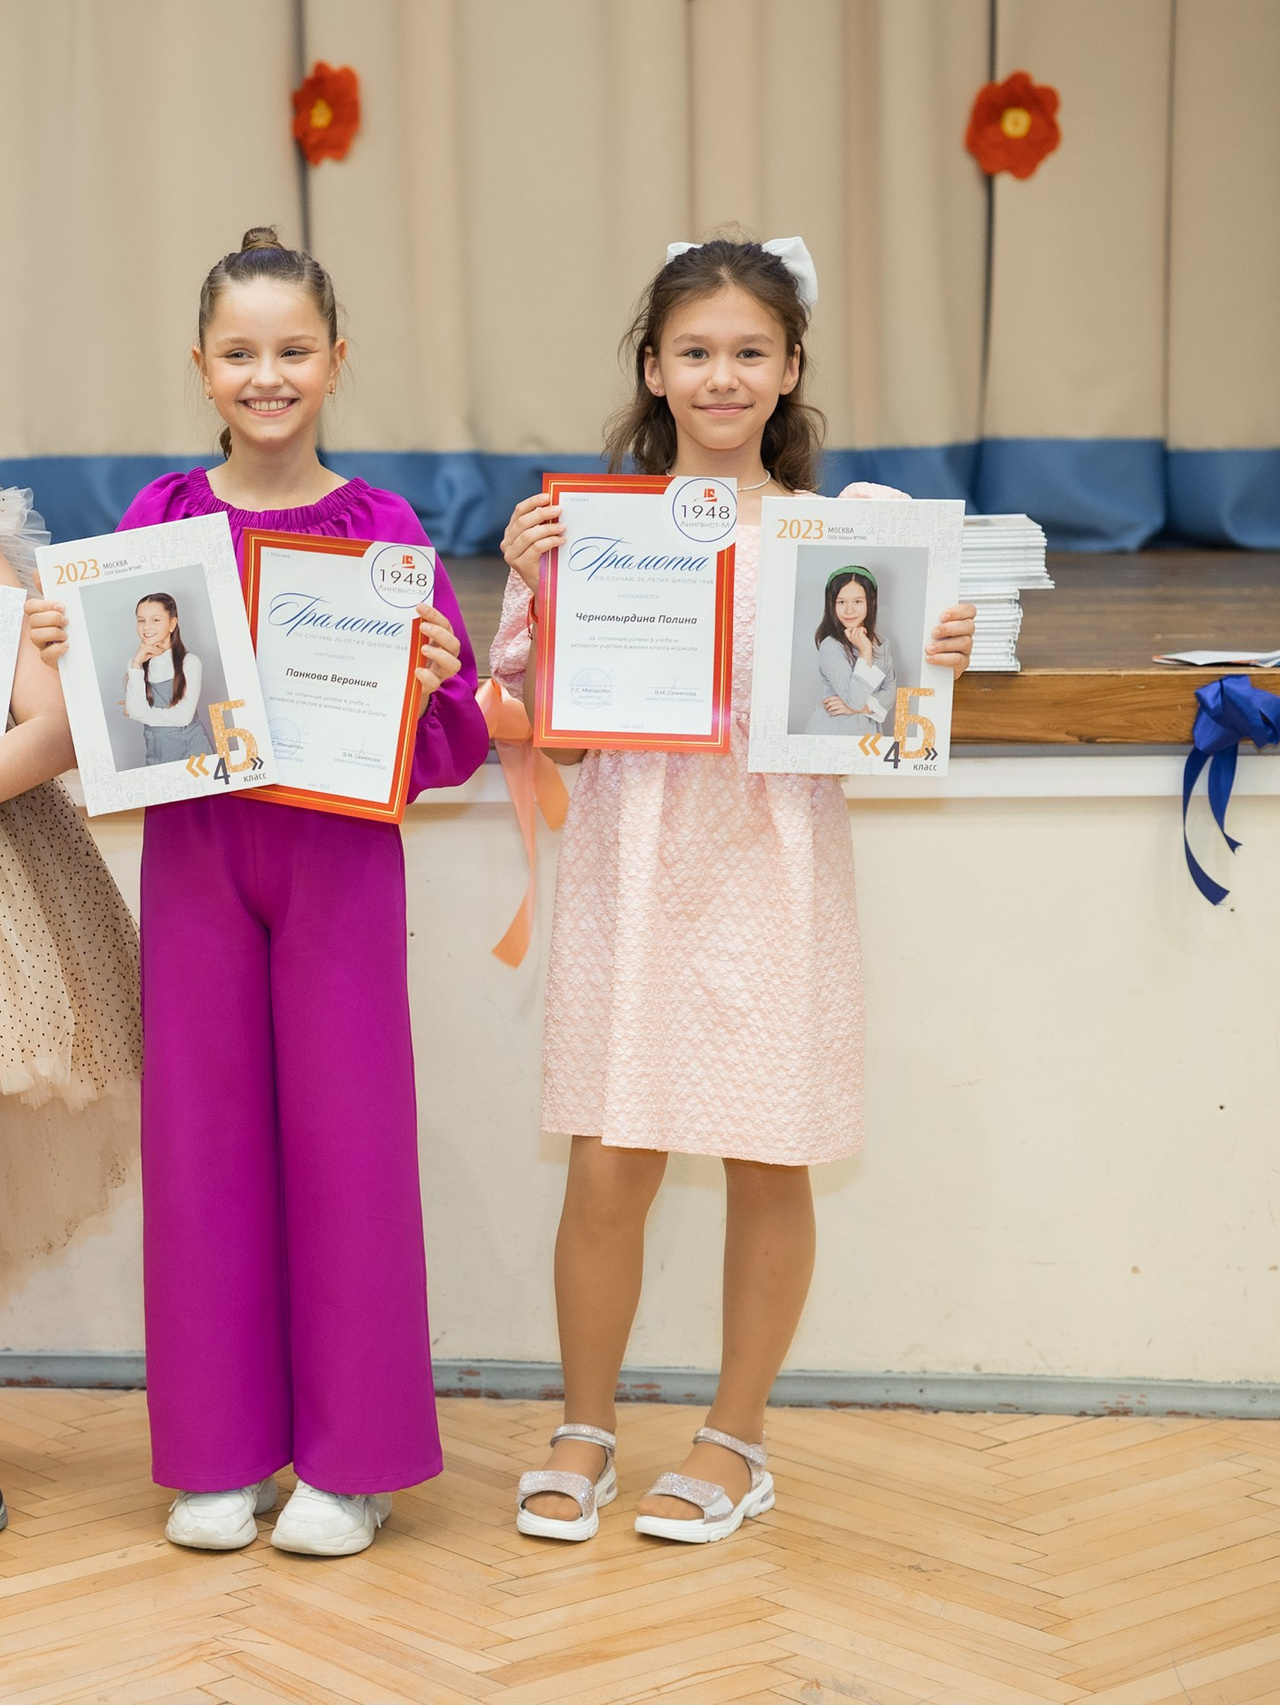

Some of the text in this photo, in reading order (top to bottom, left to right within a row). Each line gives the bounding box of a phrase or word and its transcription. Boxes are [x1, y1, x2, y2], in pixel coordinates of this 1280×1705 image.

[681, 505, 730, 520] 1948
[680, 521, 729, 529] Лингвист-М
[776, 519, 824, 540] 2023
[102, 560, 128, 570] МОСКВА
[568, 536, 710, 581] Грамота
[54, 558, 100, 585] 2023
[380, 569, 428, 587] 1948
[378, 585, 426, 596] Лингвист-М
[268, 592, 404, 637] Грамота
[576, 612, 698, 624] Черномырдина Полина
[286, 668, 378, 689] Панкова Вероника
[243, 772, 267, 783] класс
